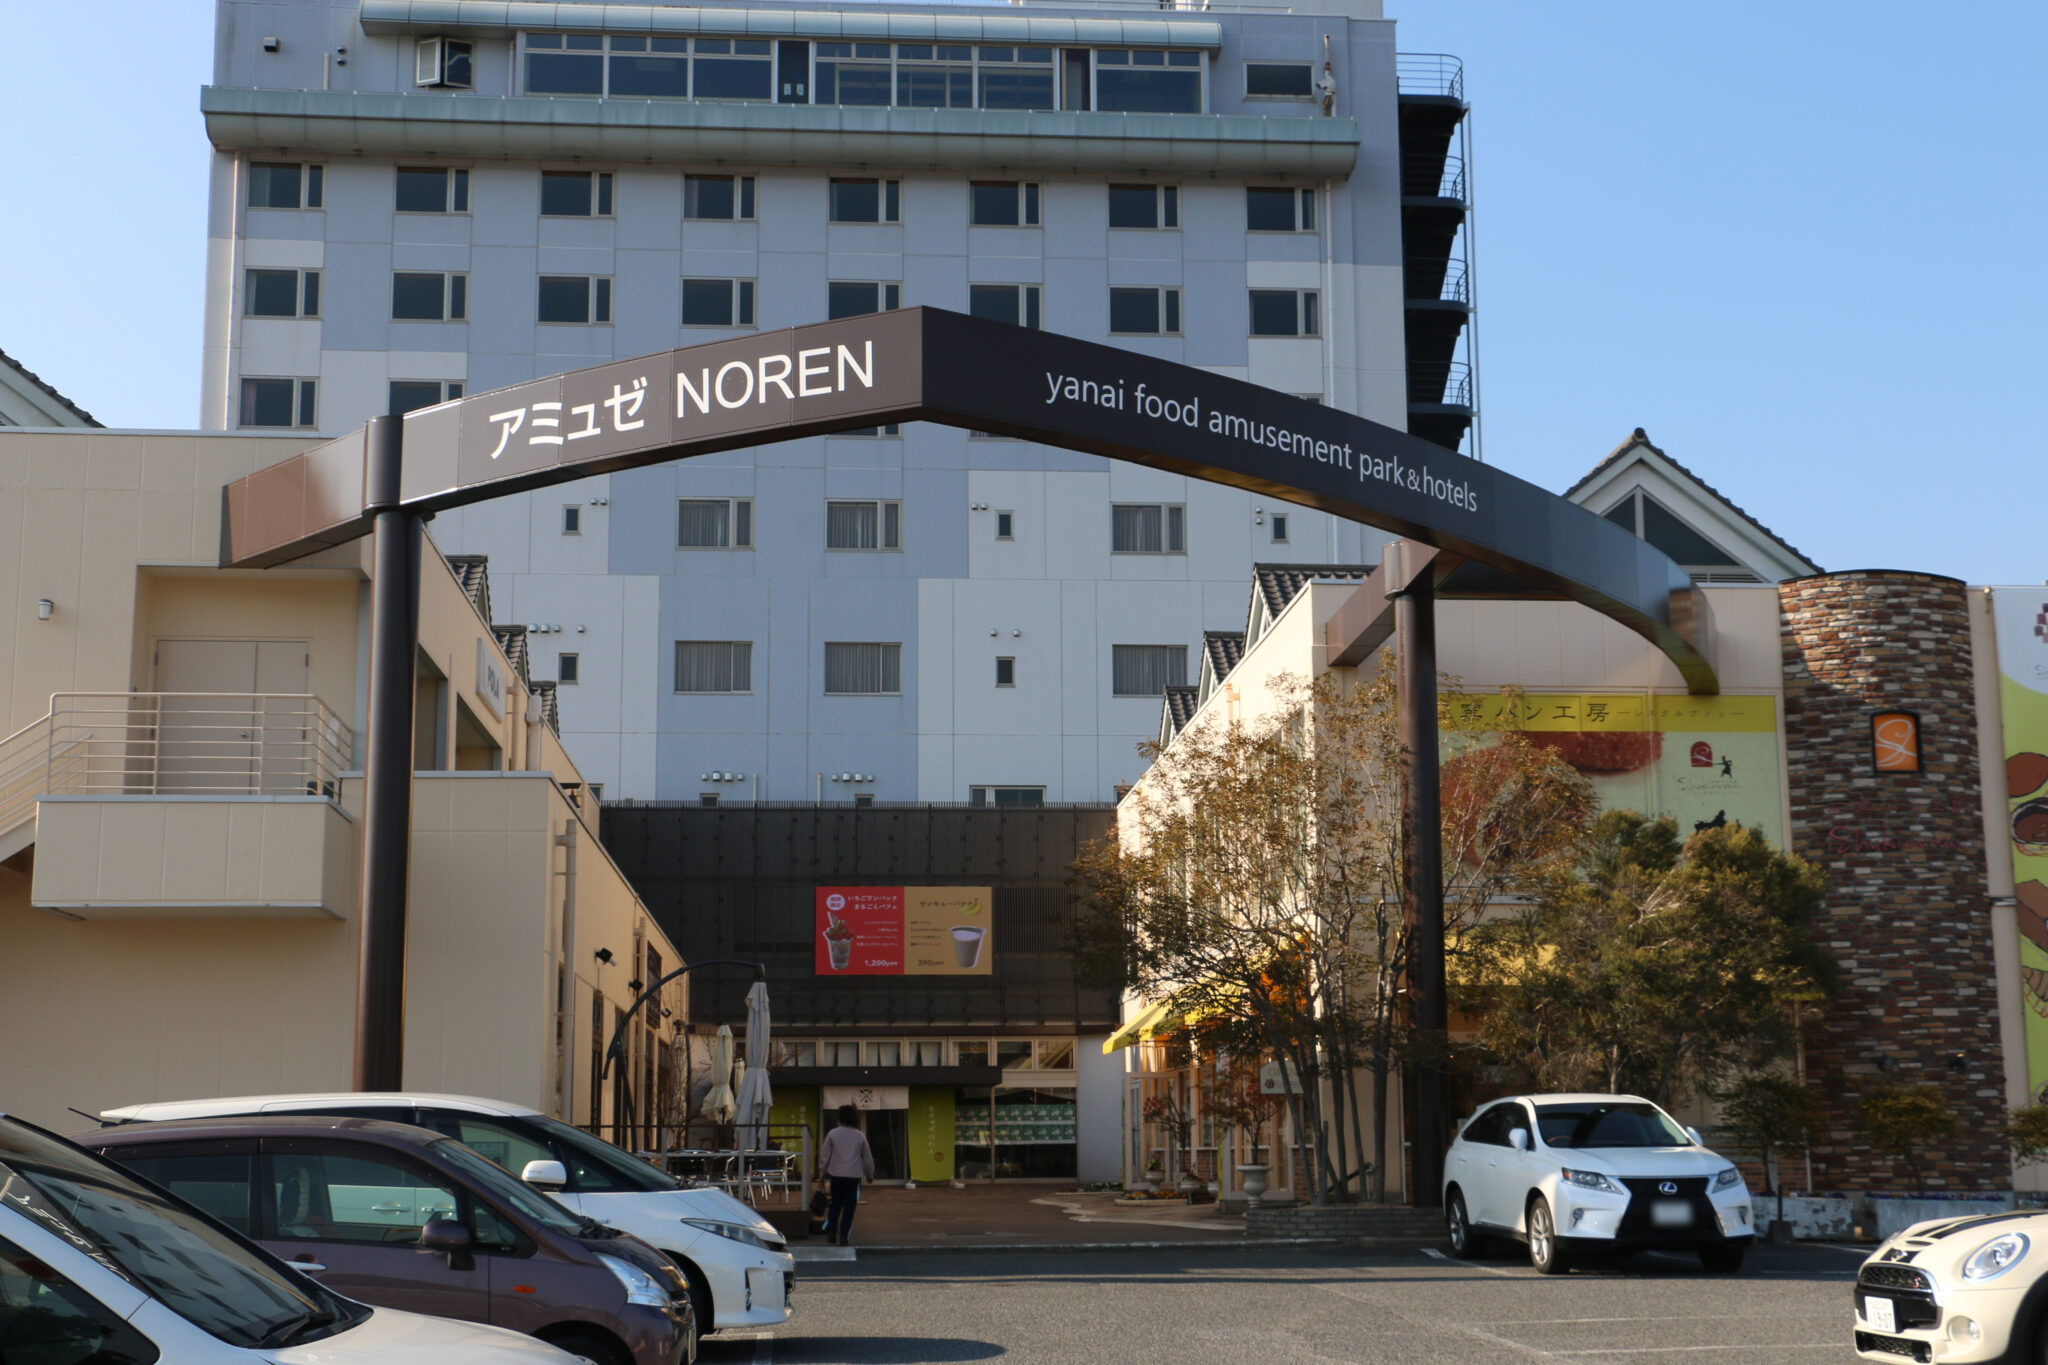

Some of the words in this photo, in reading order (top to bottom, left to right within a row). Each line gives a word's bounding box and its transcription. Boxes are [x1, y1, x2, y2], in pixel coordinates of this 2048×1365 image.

[489, 376, 648, 460] アミュゼ
[675, 341, 873, 418] NOREN
[1046, 372, 1124, 411] yanai
[1134, 382, 1198, 428] food
[1209, 409, 1353, 471] amusement
